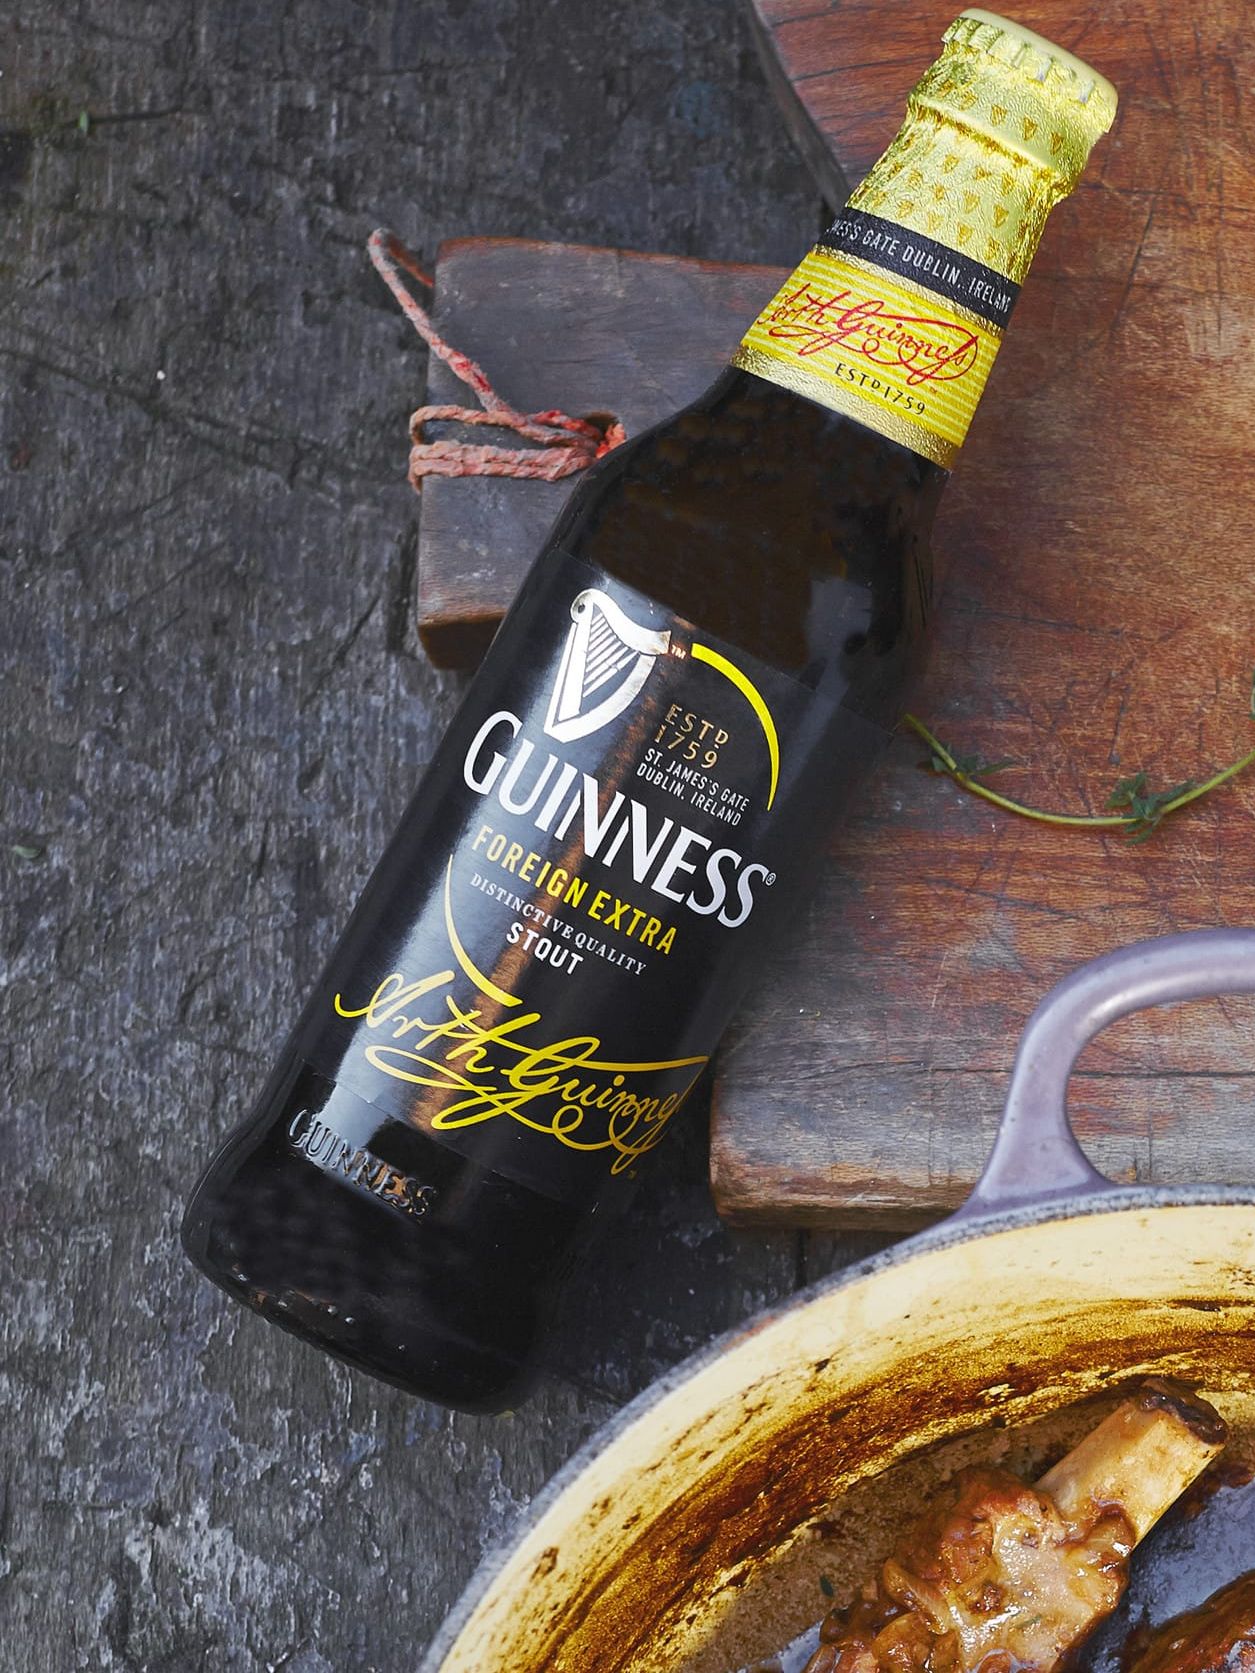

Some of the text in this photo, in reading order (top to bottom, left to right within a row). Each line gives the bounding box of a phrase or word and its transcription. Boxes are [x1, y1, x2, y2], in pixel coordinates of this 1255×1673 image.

[862, 229, 900, 255] GATE
[655, 724, 718, 769] 1759
[665, 703, 729, 749] ESTD
[645, 748, 750, 812] ST. JAMES'S GATE
[690, 791, 742, 826] IRELAND
[471, 824, 678, 955] FOREIGN EXTRA
[469, 872, 647, 976] DISTINCTIVE QUALITY
[288, 1109, 437, 1216] GUINNESS
